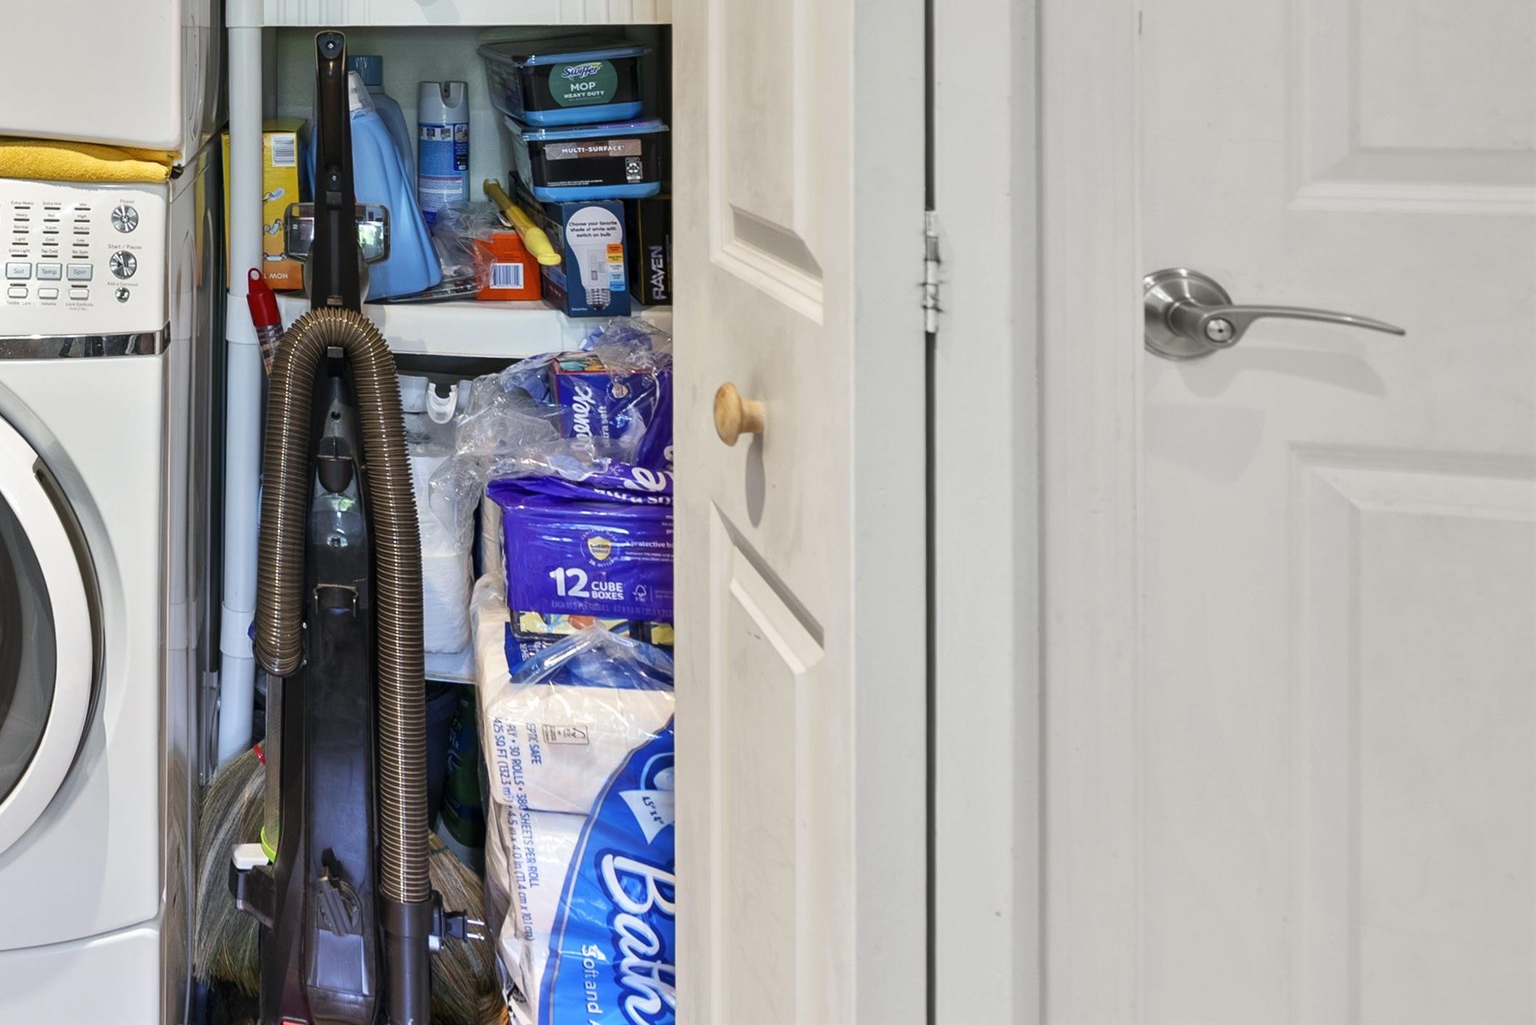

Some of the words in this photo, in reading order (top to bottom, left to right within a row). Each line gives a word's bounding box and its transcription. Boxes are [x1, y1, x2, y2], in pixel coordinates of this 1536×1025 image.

[562, 63, 602, 79] Swiffer
[570, 81, 596, 92] MOP
[41, 268, 58, 276] Temp
[73, 268, 87, 276] Spin
[649, 246, 667, 300] RAVEN
[598, 405, 608, 424] soft
[631, 541, 666, 549] protective
[549, 567, 590, 598] 12
[591, 581, 624, 592] CUBE
[591, 591, 624, 601] BOXES
[494, 735, 506, 748] SQ
[497, 748, 508, 759] FT
[509, 745, 521, 757] 30
[530, 744, 542, 765] SAFE
[497, 760, 512, 785] (132.3
[511, 758, 525, 786] ROLLS
[516, 793, 529, 811] 380
[507, 810, 518, 826] 4.5
[509, 826, 519, 835] in
[518, 812, 534, 846] SHEETS
[511, 844, 523, 860] 4.0
[524, 847, 536, 864] PER
[513, 861, 525, 870] in
[512, 871, 528, 890] (11.4
[527, 865, 541, 889] ROLL
[518, 891, 529, 904] cm
[524, 926, 536, 942] cm)
[601, 853, 674, 1025] Bath
[581, 944, 601, 979] Soft
[584, 981, 601, 1015] and
